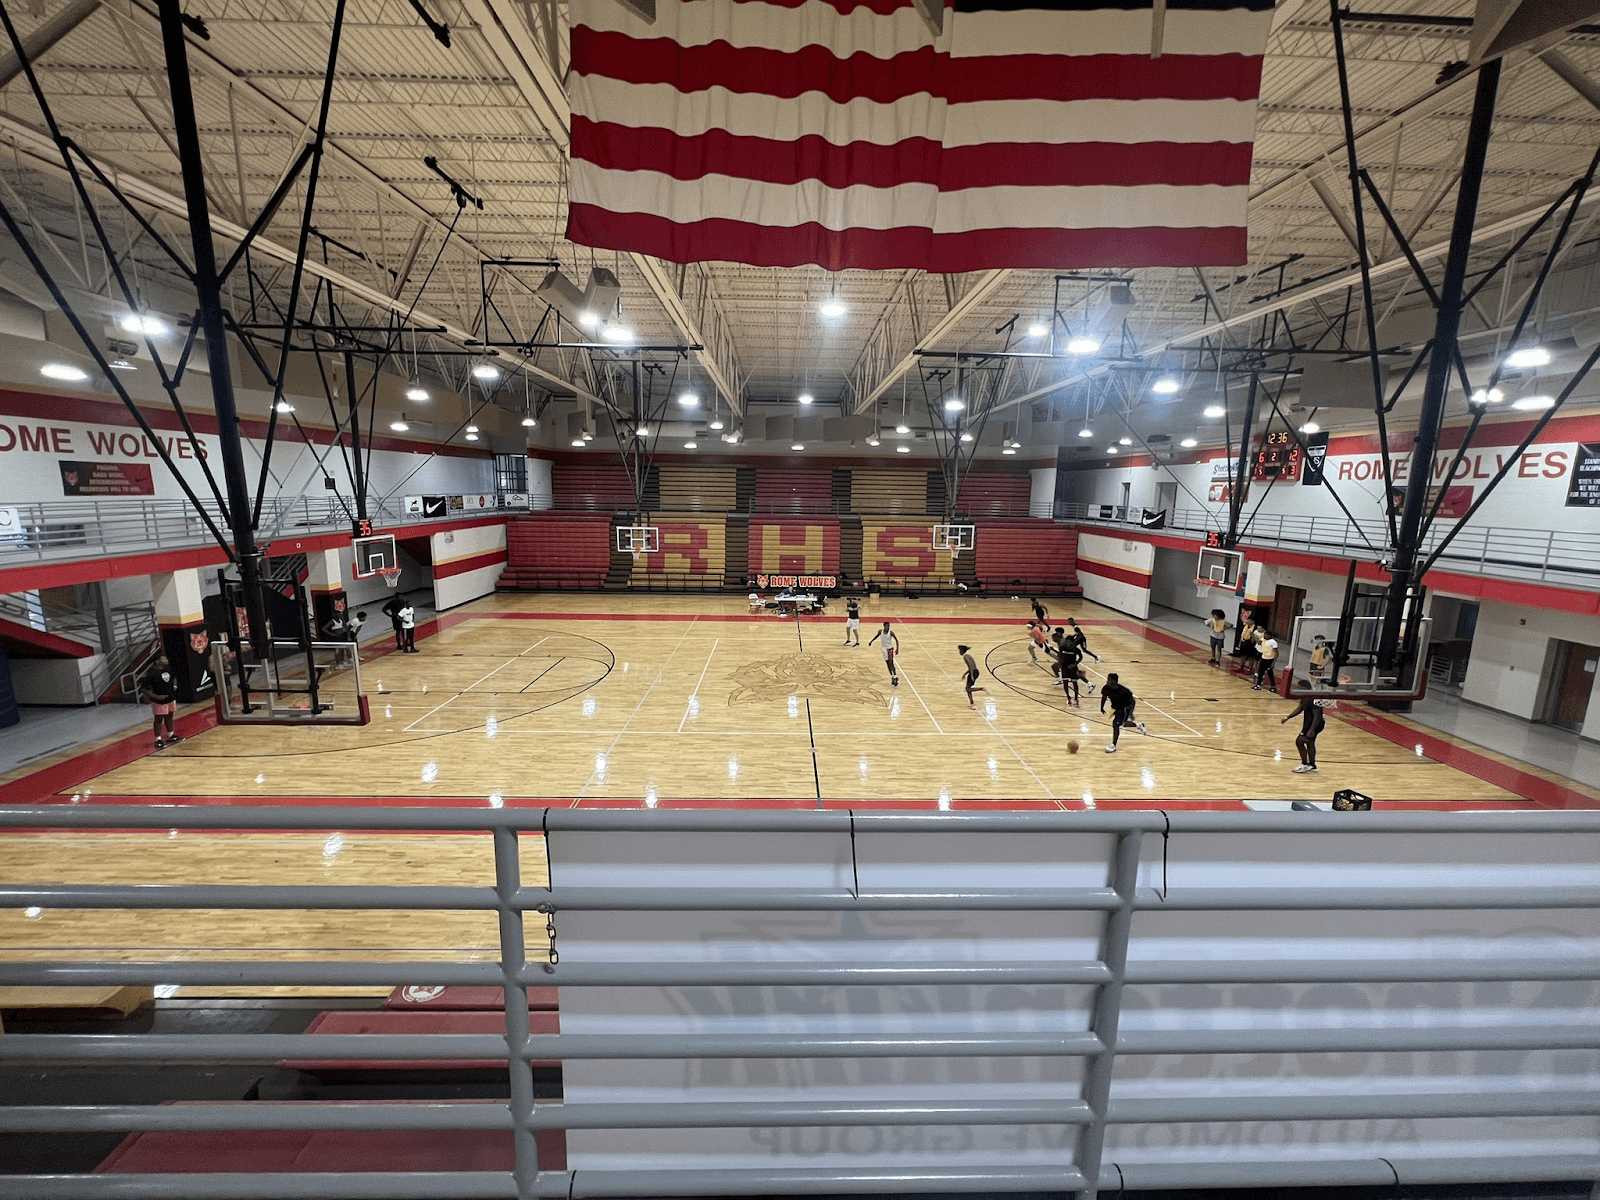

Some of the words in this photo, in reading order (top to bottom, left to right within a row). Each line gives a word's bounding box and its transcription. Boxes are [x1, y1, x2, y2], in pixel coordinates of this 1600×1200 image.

[87, 430, 208, 462] WOLVES
[1271, 452, 1276, 461] 2
[1338, 459, 1409, 481] ROME
[359, 521, 371, 536] 35
[770, 575, 797, 587] ROME
[798, 575, 836, 588] WOLVES
